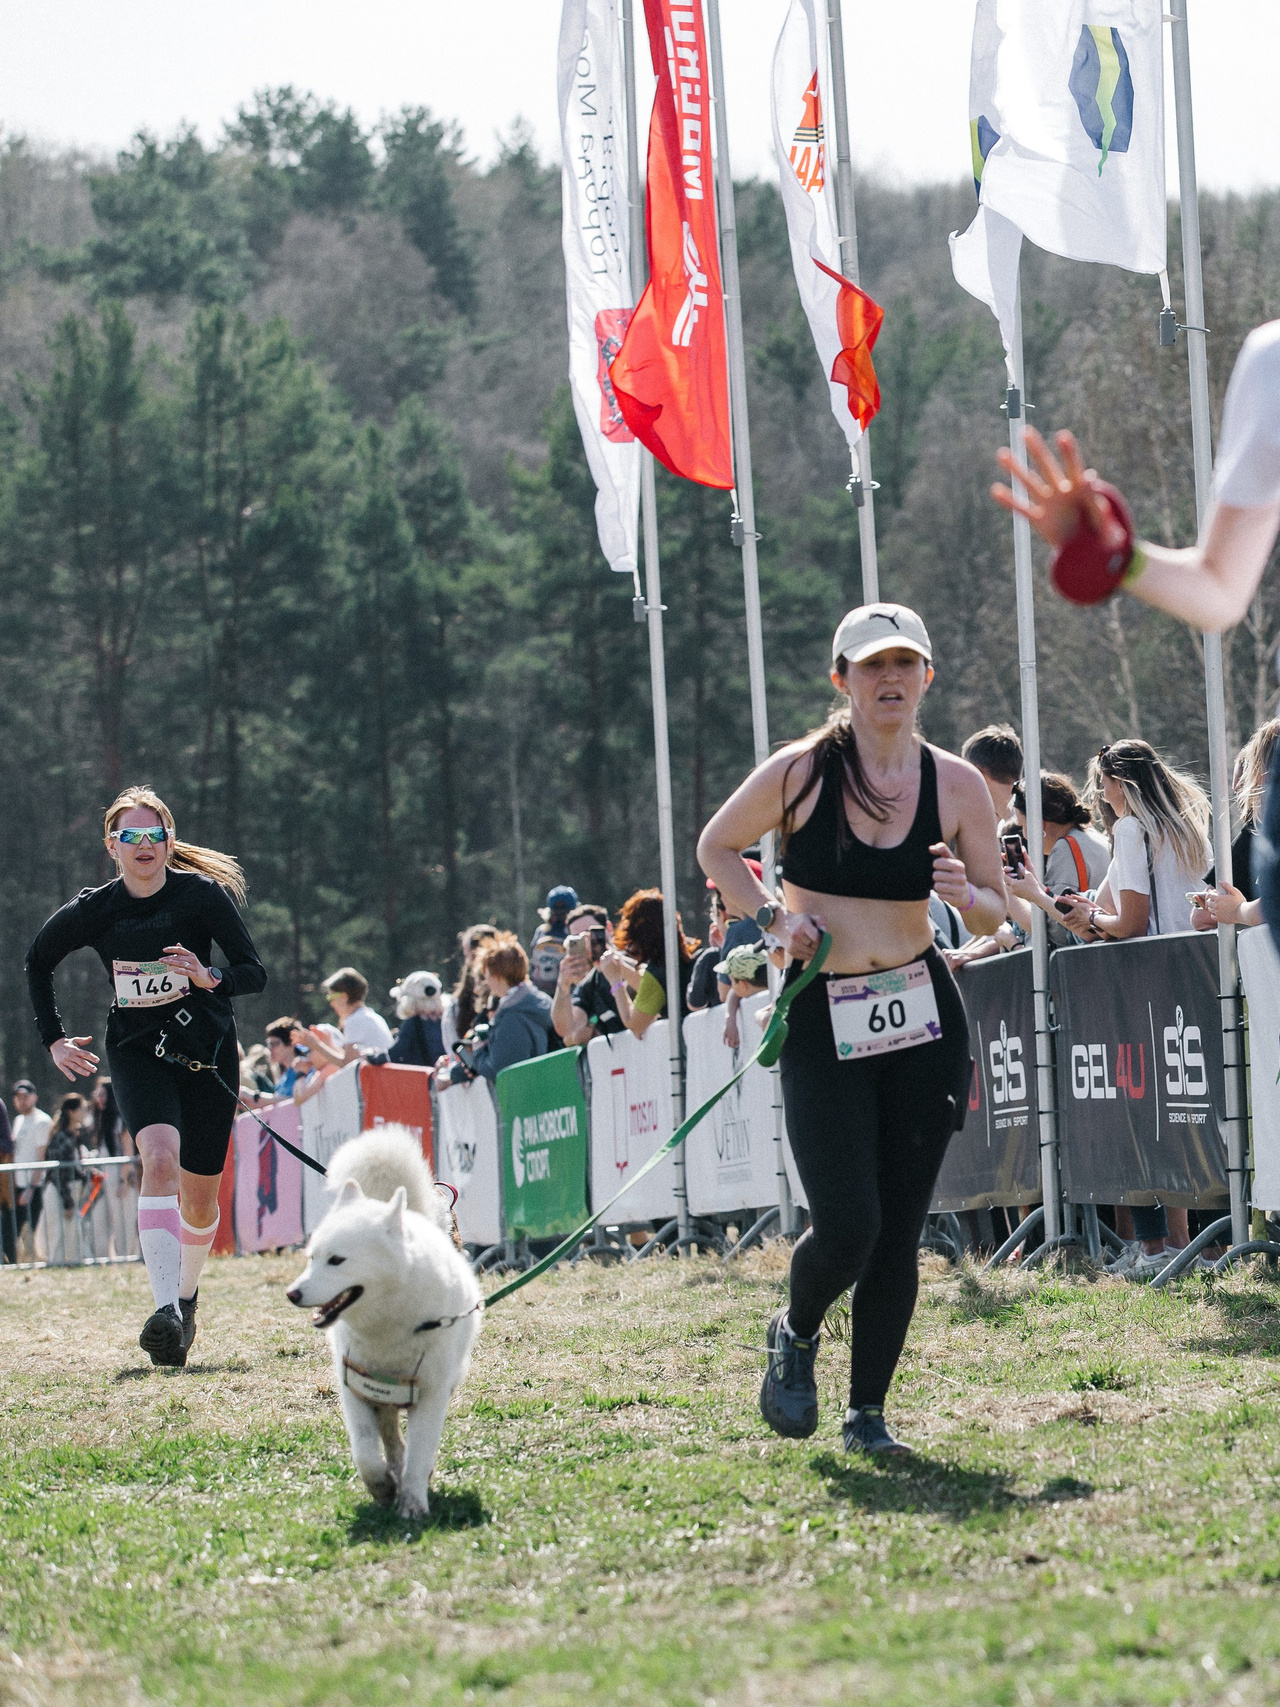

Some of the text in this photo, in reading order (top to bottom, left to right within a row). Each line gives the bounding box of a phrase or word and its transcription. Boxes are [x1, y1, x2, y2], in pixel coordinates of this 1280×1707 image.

[132, 975, 173, 996] 146
[868, 999, 906, 1033] 60
[526, 1148, 551, 1184] СПОРТ
